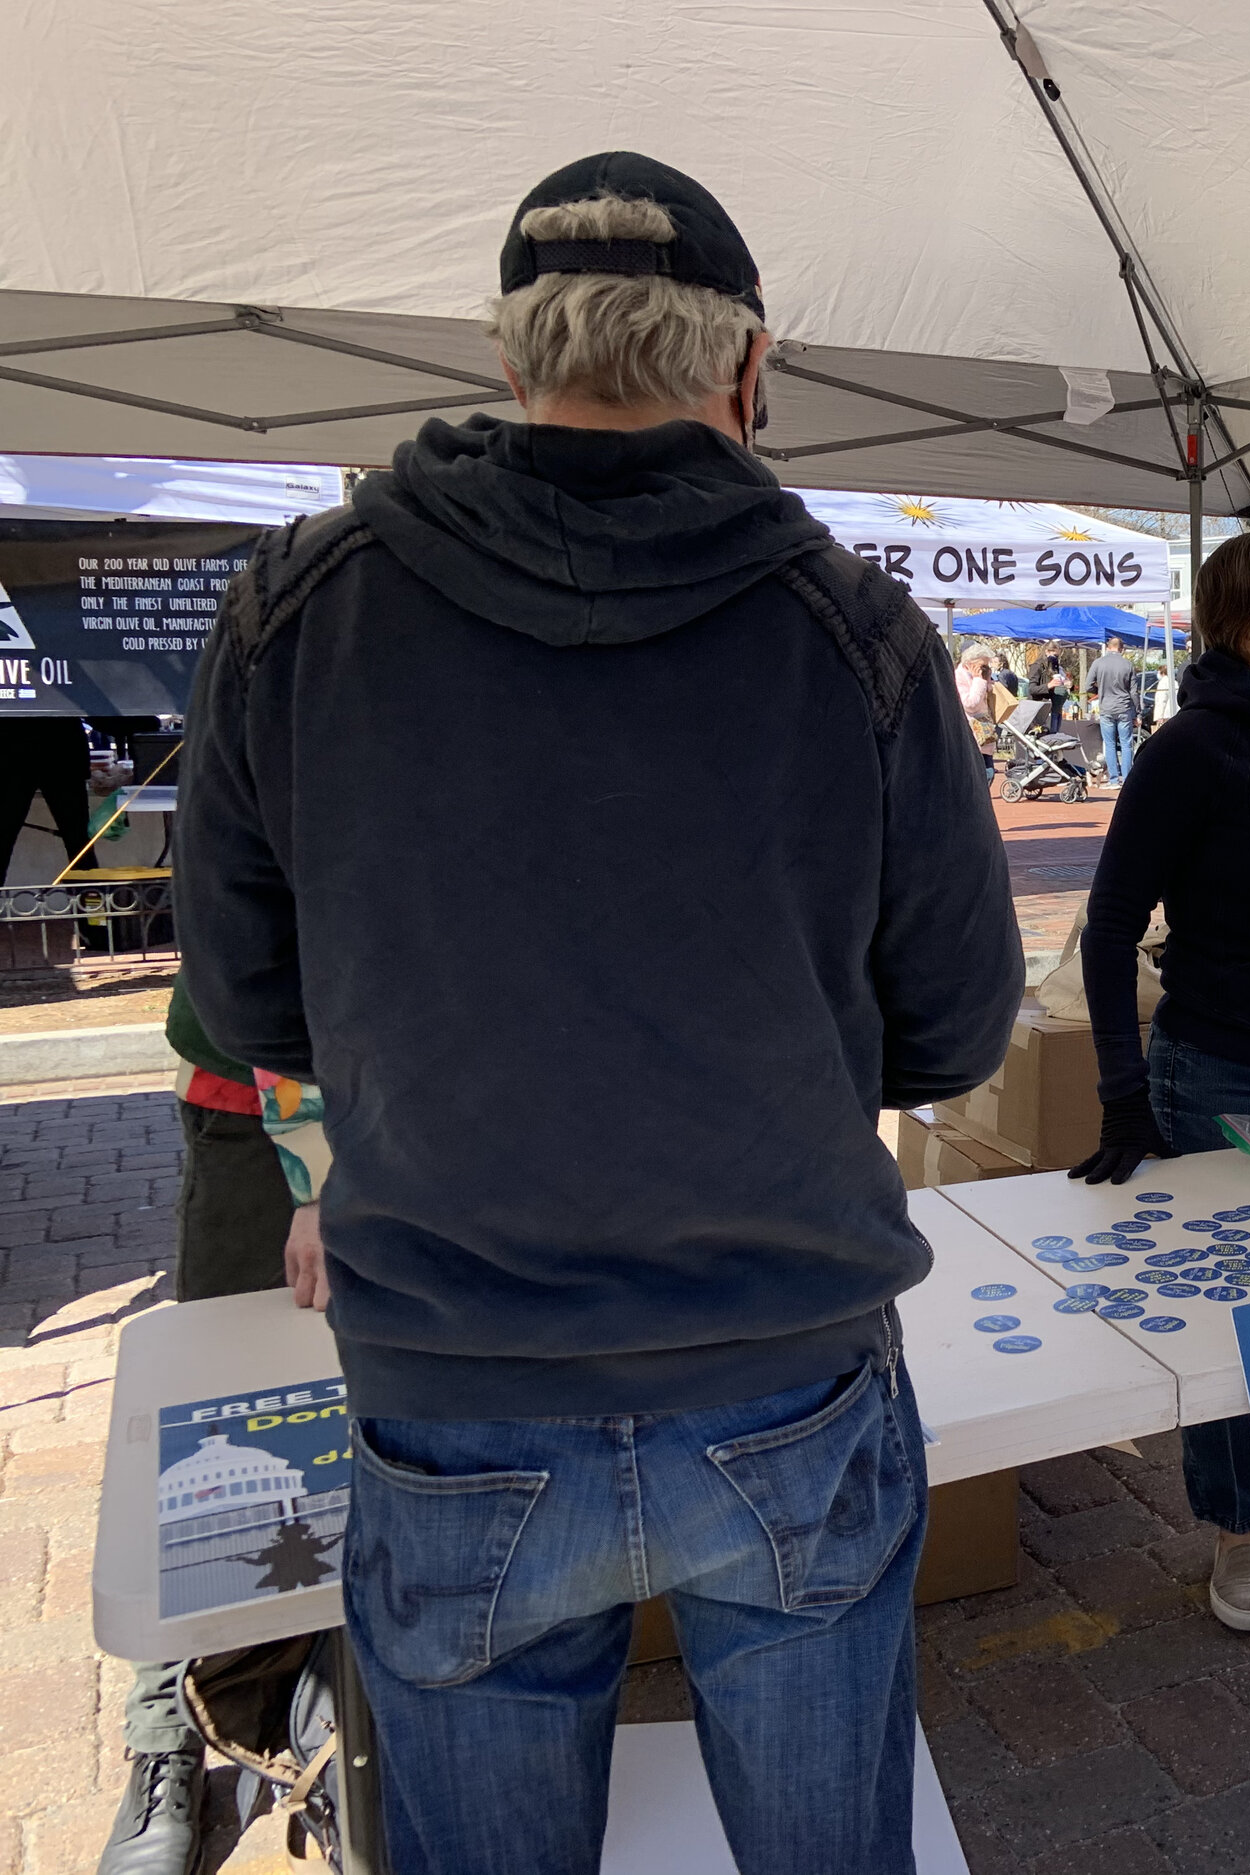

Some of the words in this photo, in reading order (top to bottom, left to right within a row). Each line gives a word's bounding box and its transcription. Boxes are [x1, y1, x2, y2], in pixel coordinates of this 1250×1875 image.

[286, 482, 320, 493] Galaxy
[78, 557, 98, 570] OUR
[104, 559, 123, 570] 200
[127, 558, 148, 570] YEAR
[153, 558, 169, 571] OLD
[173, 558, 197, 571] OLIVE
[201, 559, 230, 571] FARMS
[835, 543, 913, 579] ER
[933, 546, 1017, 584] ONE
[1035, 550, 1142, 588] SONS
[80, 576, 96, 589] THE
[102, 576, 172, 590] MEDITERRANEAN
[178, 578, 204, 591] COAST
[210, 578, 231, 592] PRO
[81, 596, 104, 609] ONLY
[112, 597, 128, 610] THE
[135, 597, 162, 610] FINEST
[169, 598, 217, 611] UNFILTERED
[82, 617, 112, 630] VIRGIN
[116, 617, 140, 630] OLIVE
[143, 617, 160, 631] OIL,
[123, 637, 145, 650] COLD
[148, 637, 183, 650] PRESSED
[186, 637, 198, 650] BY
[0, 659, 31, 685] IVE
[41, 657, 73, 685] OIL
[191, 1389, 313, 1423] FREE
